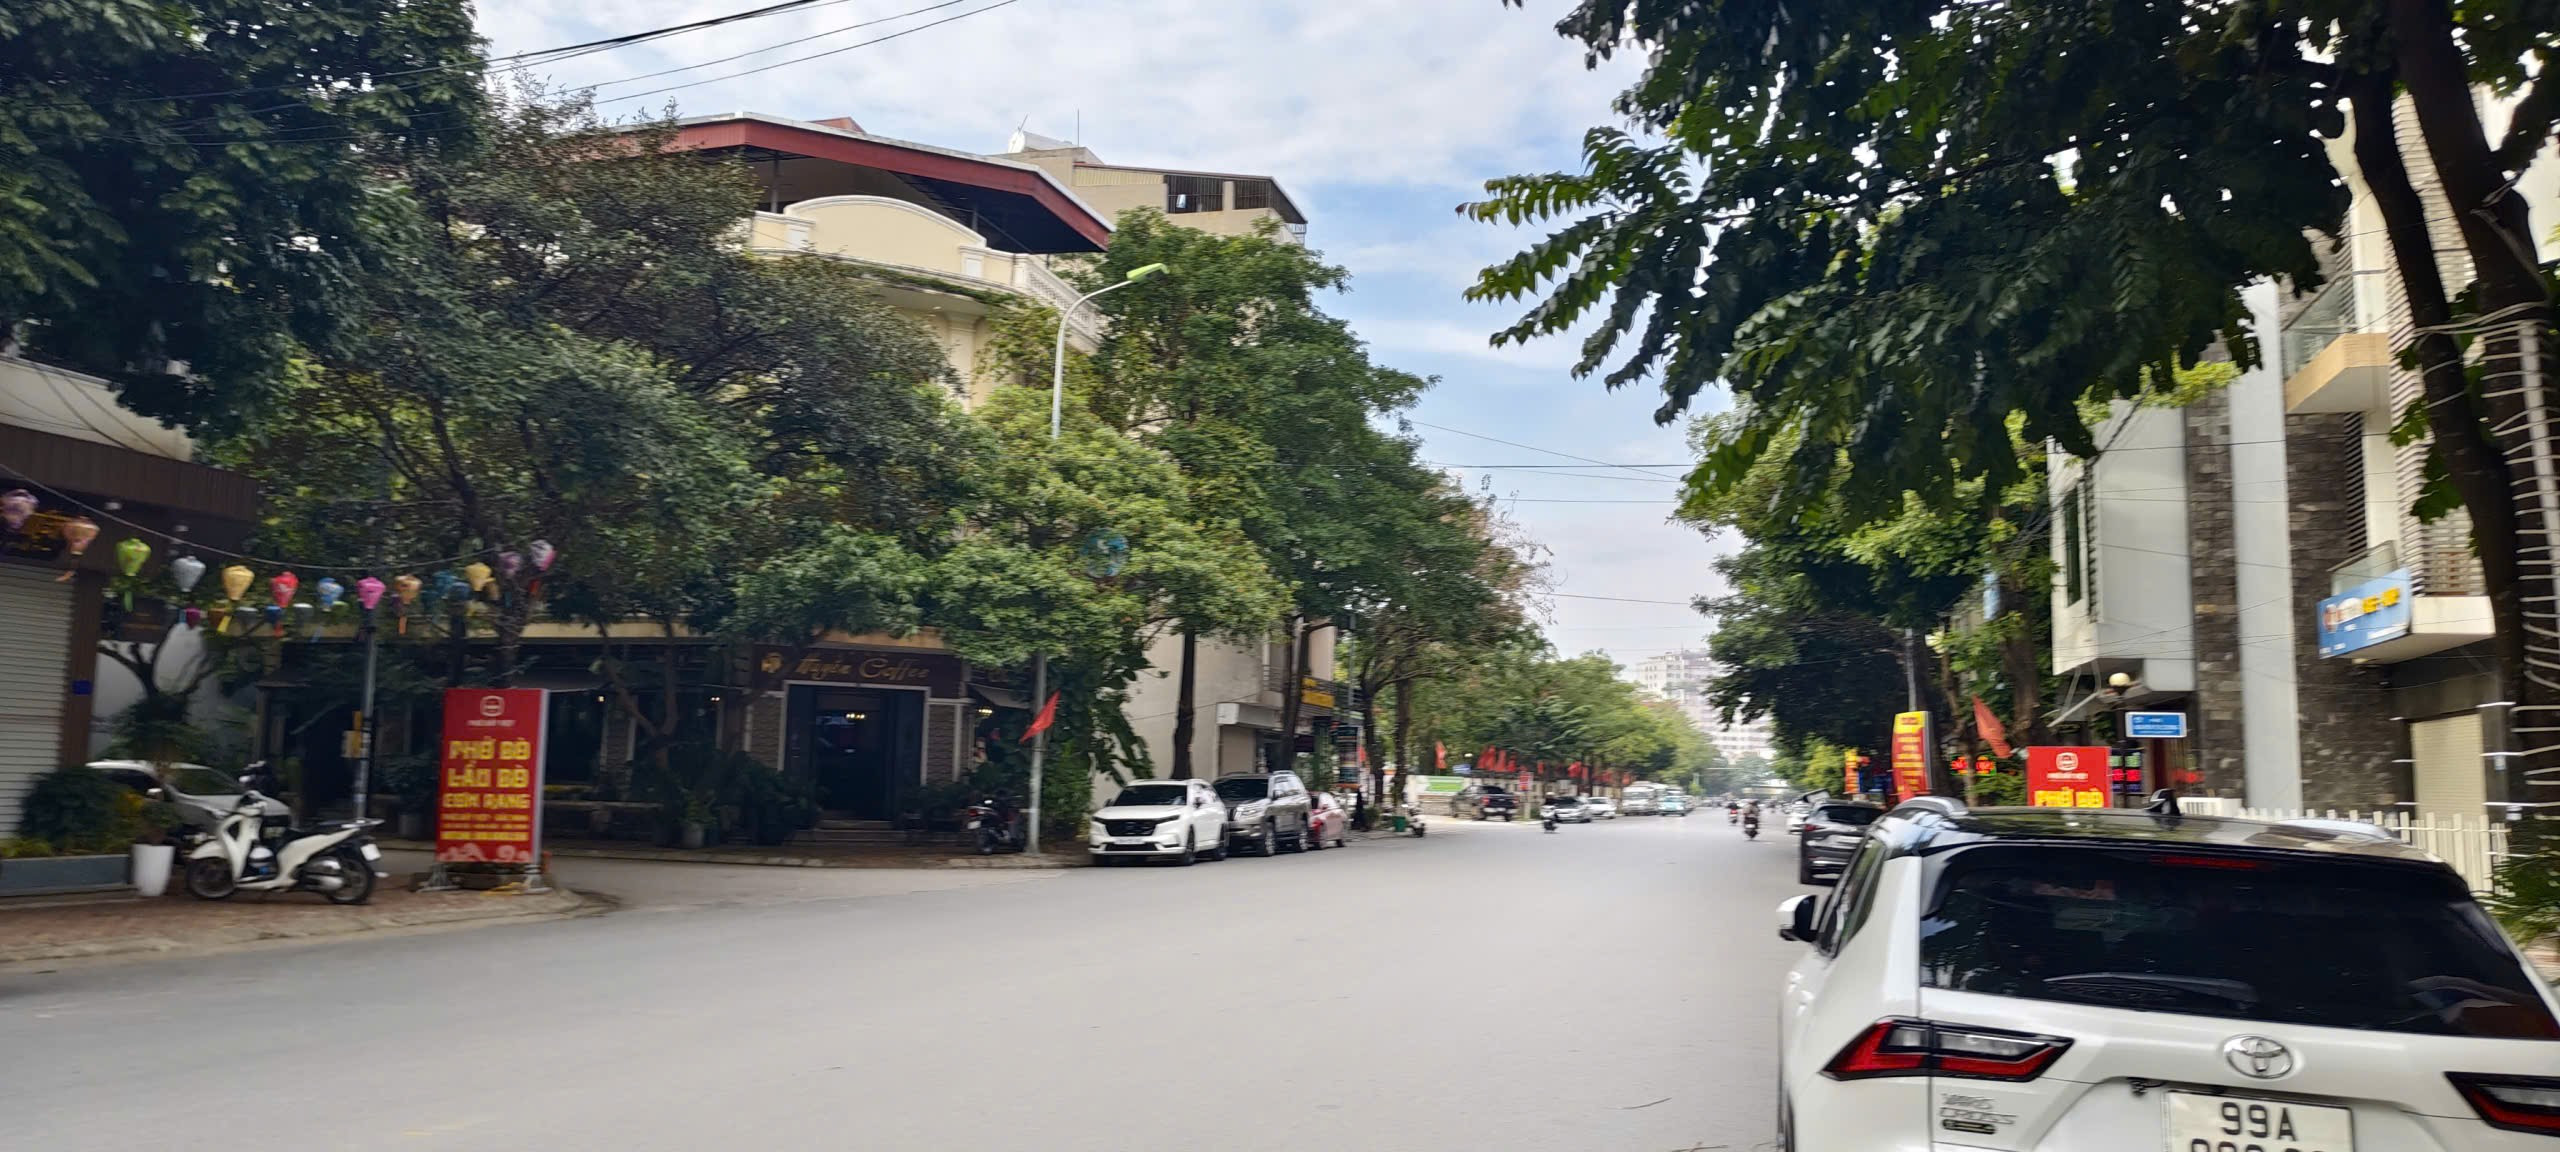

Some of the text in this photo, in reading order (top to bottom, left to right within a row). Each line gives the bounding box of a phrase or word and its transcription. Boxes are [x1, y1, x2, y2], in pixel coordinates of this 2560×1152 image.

[858, 657, 930, 681] Coffee
[448, 736, 495, 760] PHỞ
[2221, 1101, 2297, 1142] 99A
